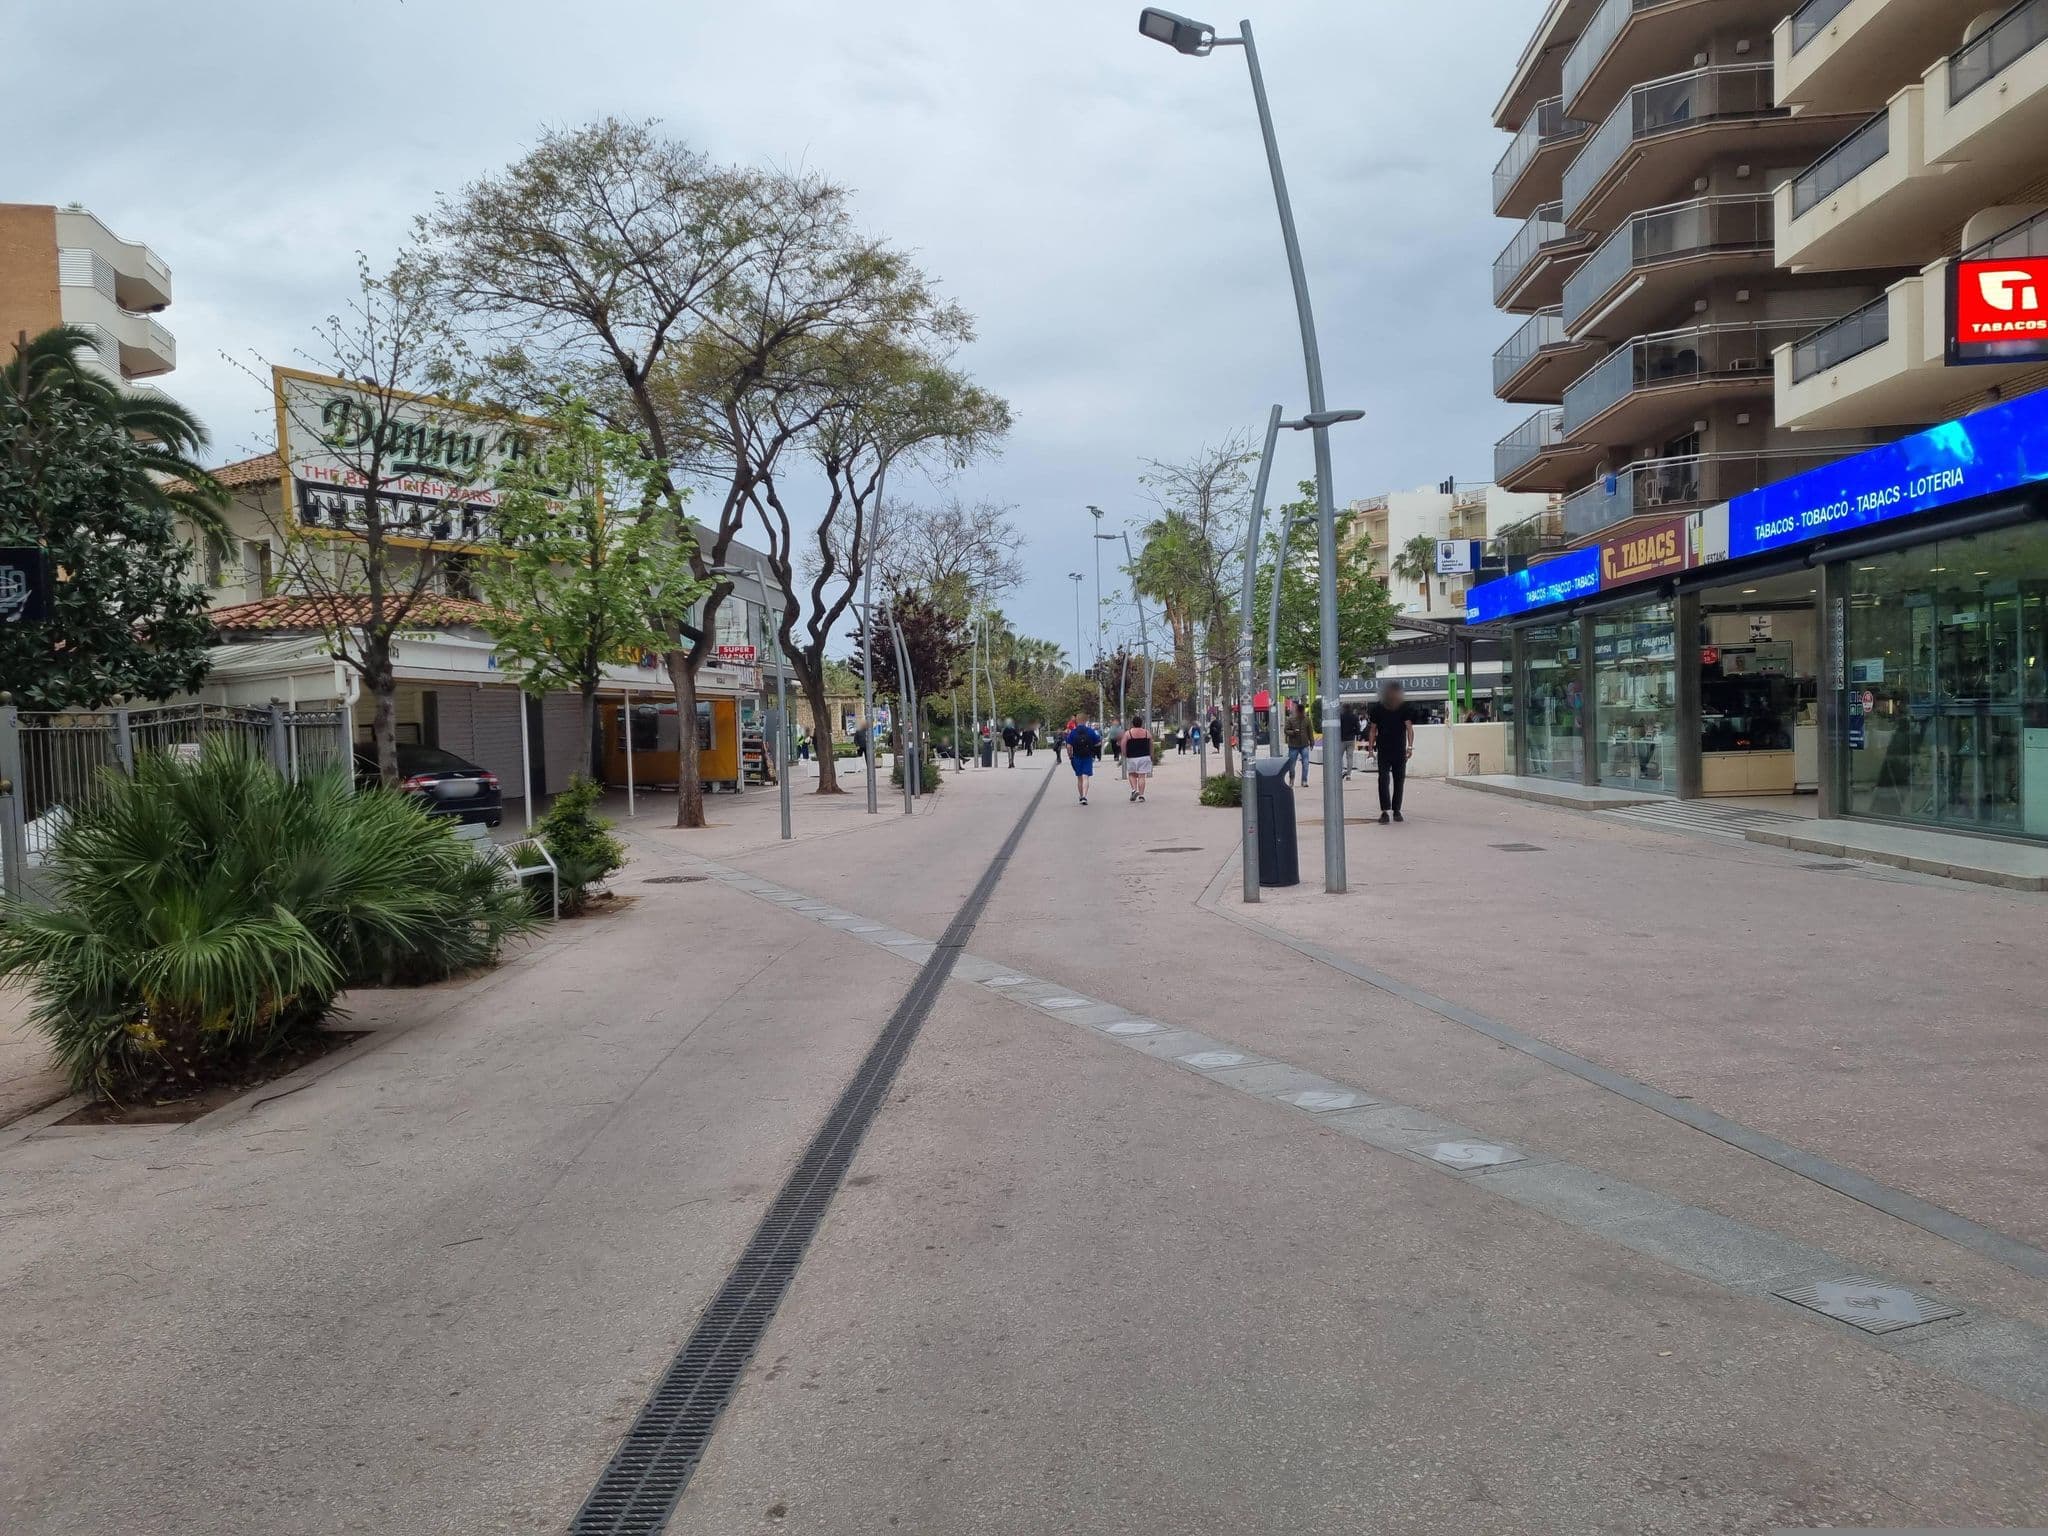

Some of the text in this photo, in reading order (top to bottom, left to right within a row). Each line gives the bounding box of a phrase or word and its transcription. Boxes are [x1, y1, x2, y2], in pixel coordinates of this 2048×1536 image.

[1972, 320, 2047, 333] TABACOS
[302, 464, 339, 482] THE
[345, 470, 389, 489] BET
[397, 479, 443, 497] IRISH
[1755, 467, 1964, 541] TABACOS TOBACCO TABACS LOTERIA
[1621, 530, 1675, 569] TABACS
[1281, 677, 1296, 686] ATM
[1401, 677, 1441, 689] TORE
